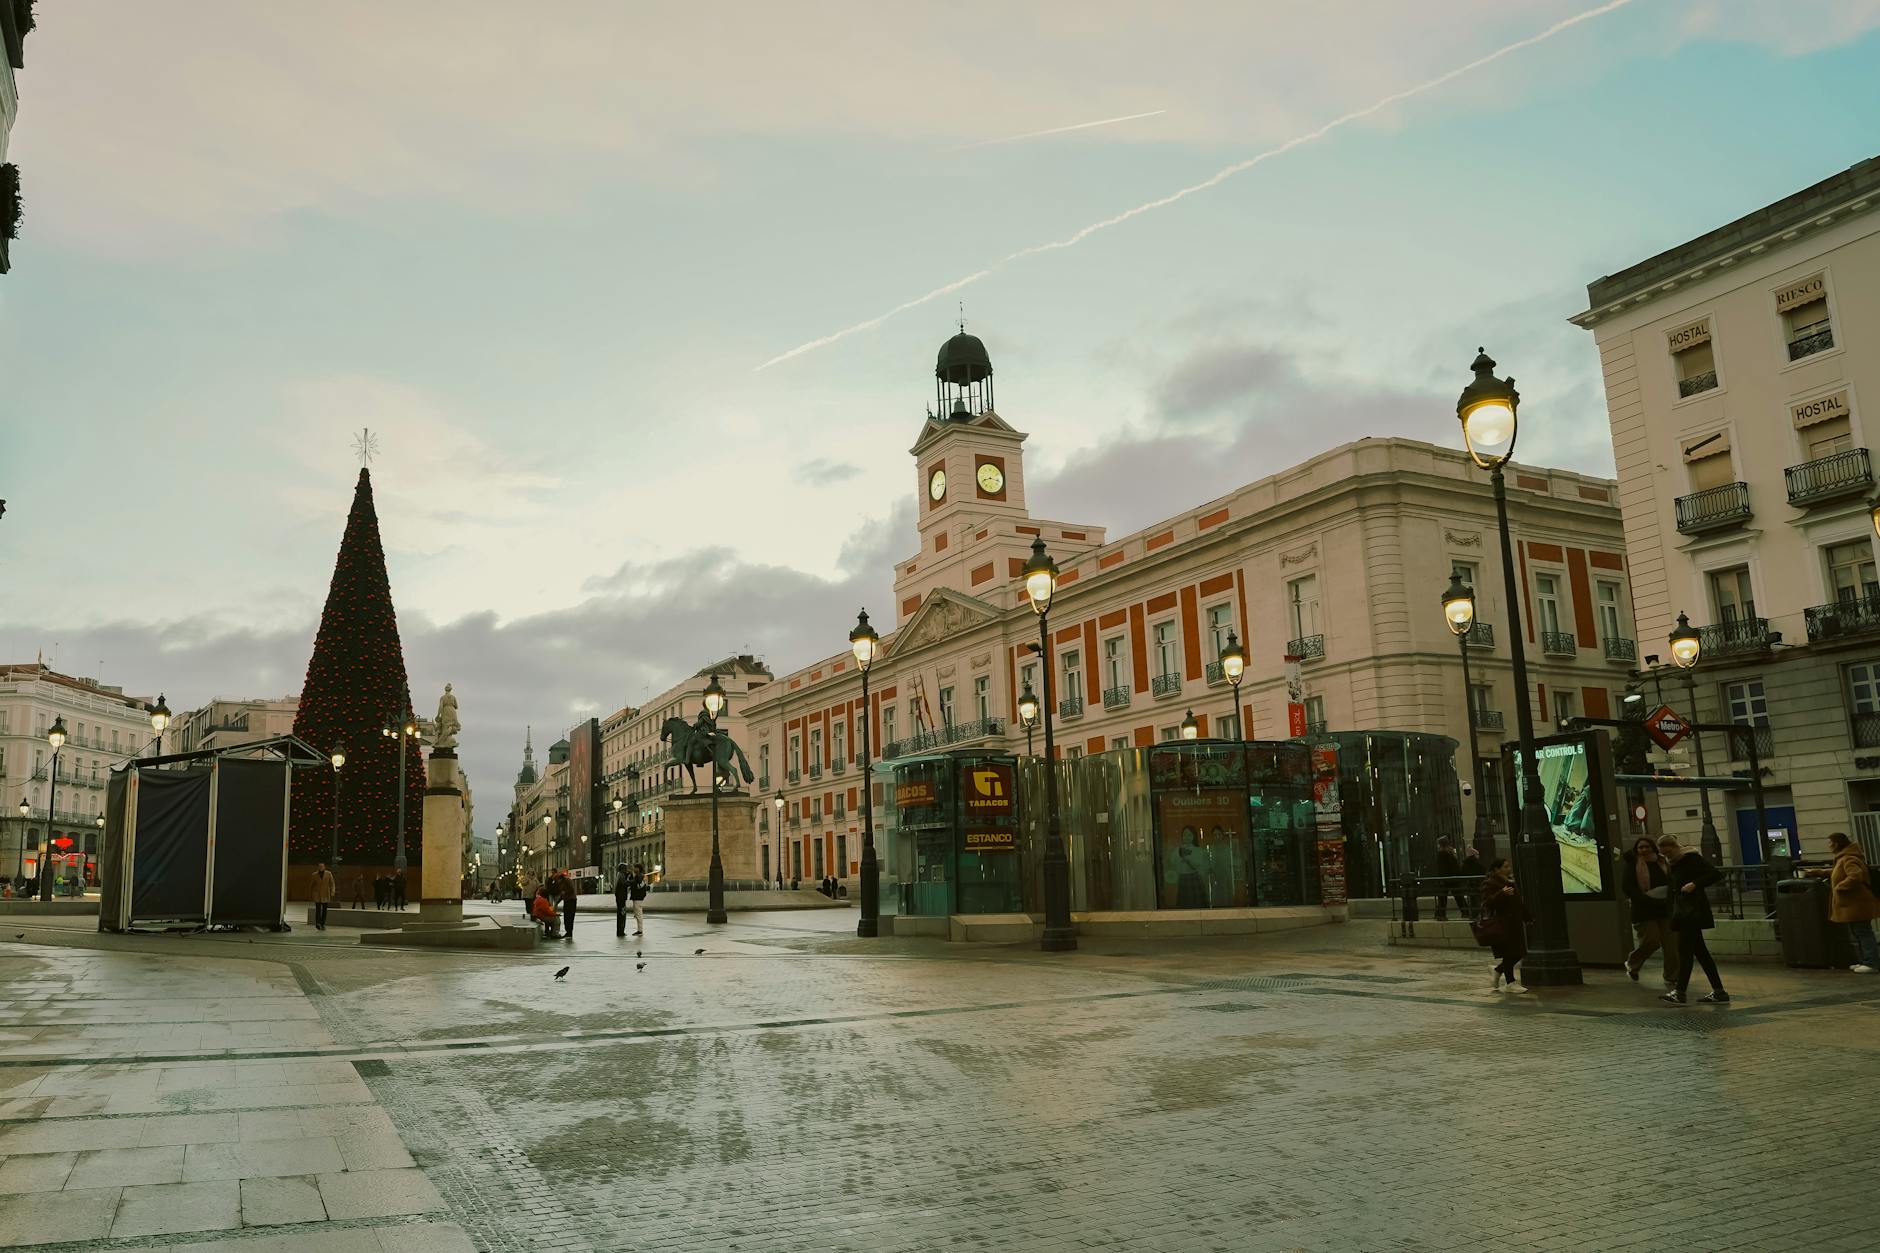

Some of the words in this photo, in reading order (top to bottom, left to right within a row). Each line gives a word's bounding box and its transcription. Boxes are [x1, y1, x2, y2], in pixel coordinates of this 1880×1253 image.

[1777, 280, 1823, 305] RIESCO
[1669, 324, 1708, 348] HOSTAL
[1796, 397, 1842, 421] HOSTAL
[1660, 721, 1680, 731] Metro
[968, 799, 1009, 807] TABACOS
[966, 833, 1012, 843] ESTANCO
